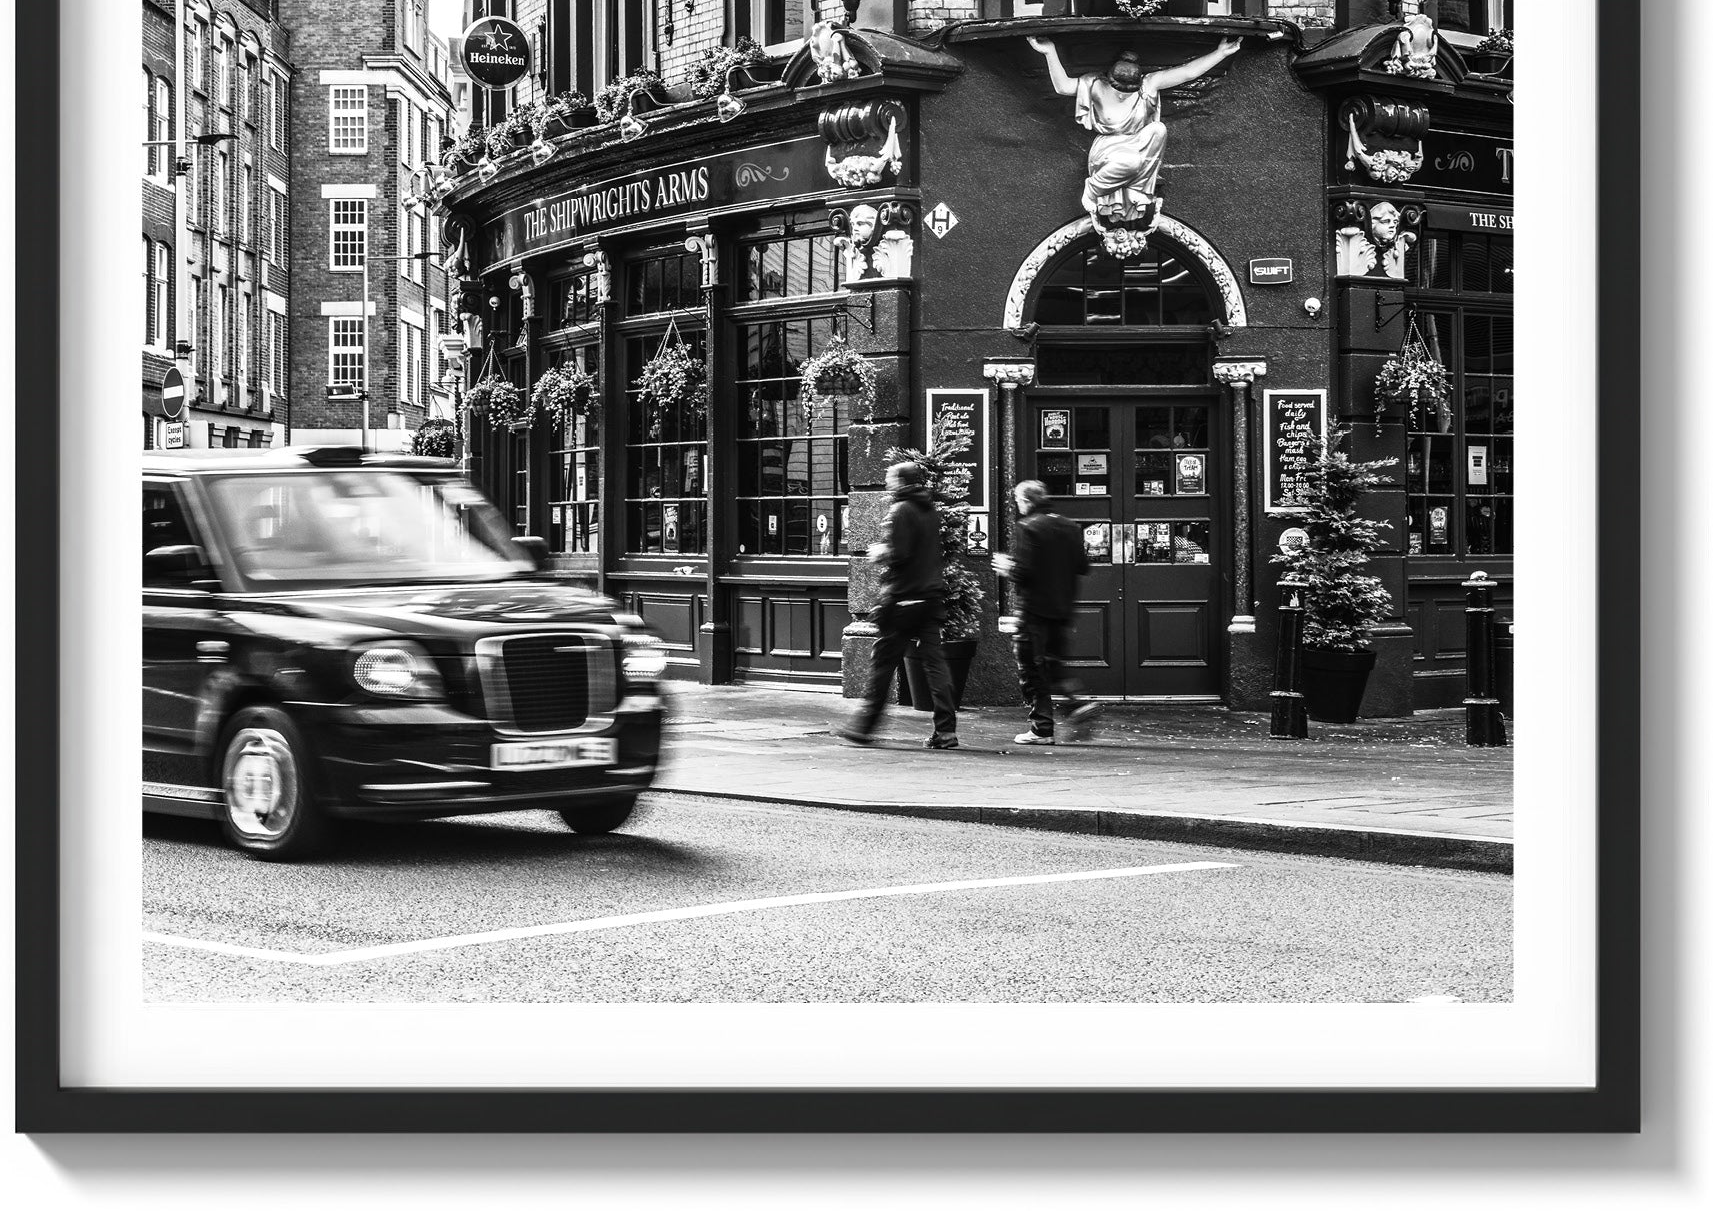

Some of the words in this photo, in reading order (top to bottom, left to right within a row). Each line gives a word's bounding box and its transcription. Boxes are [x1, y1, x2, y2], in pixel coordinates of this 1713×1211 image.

[470, 53, 525, 66] Heineken
[523, 207, 548, 240] THE
[550, 179, 650, 232] SHIPWRIGHTS
[654, 166, 709, 209] ARMS
[932, 210, 950, 230] H
[1469, 212, 1497, 228] THE
[1253, 266, 1290, 276] SWIFT
[1277, 399, 1293, 410] Food
[1294, 400, 1315, 409] served
[1285, 409, 1307, 421] daily
[1280, 420, 1296, 432] Fish
[1296, 421, 1311, 430] and
